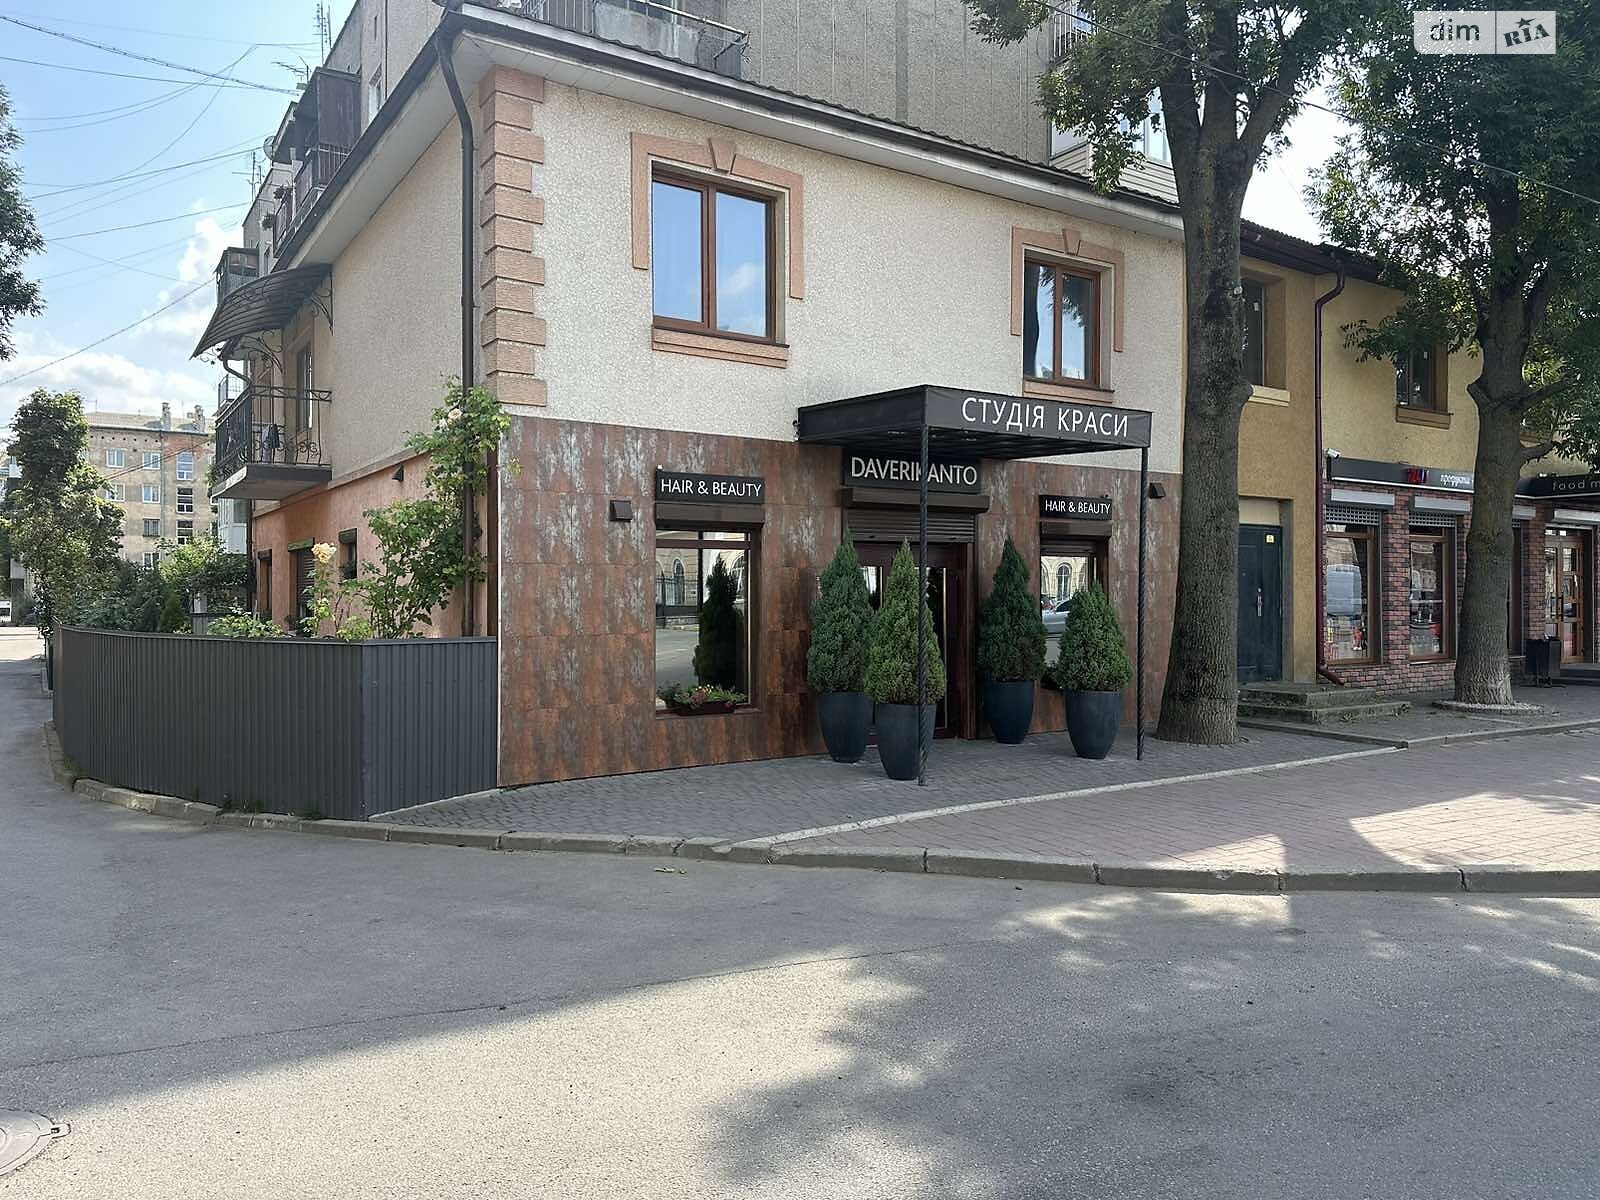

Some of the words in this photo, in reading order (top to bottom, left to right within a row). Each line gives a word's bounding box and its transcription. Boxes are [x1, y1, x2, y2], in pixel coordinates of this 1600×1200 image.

[962, 397, 1045, 432] СТУДІЯ
[1058, 407, 1128, 437] КРАСИ
[661, 478, 694, 494] HAIR
[697, 480, 709, 495] &
[712, 481, 762, 497] BEAUTY
[1045, 499, 1066, 512] HAIR
[1068, 501, 1076, 513] &
[1078, 501, 1111, 515] BEAUTY
